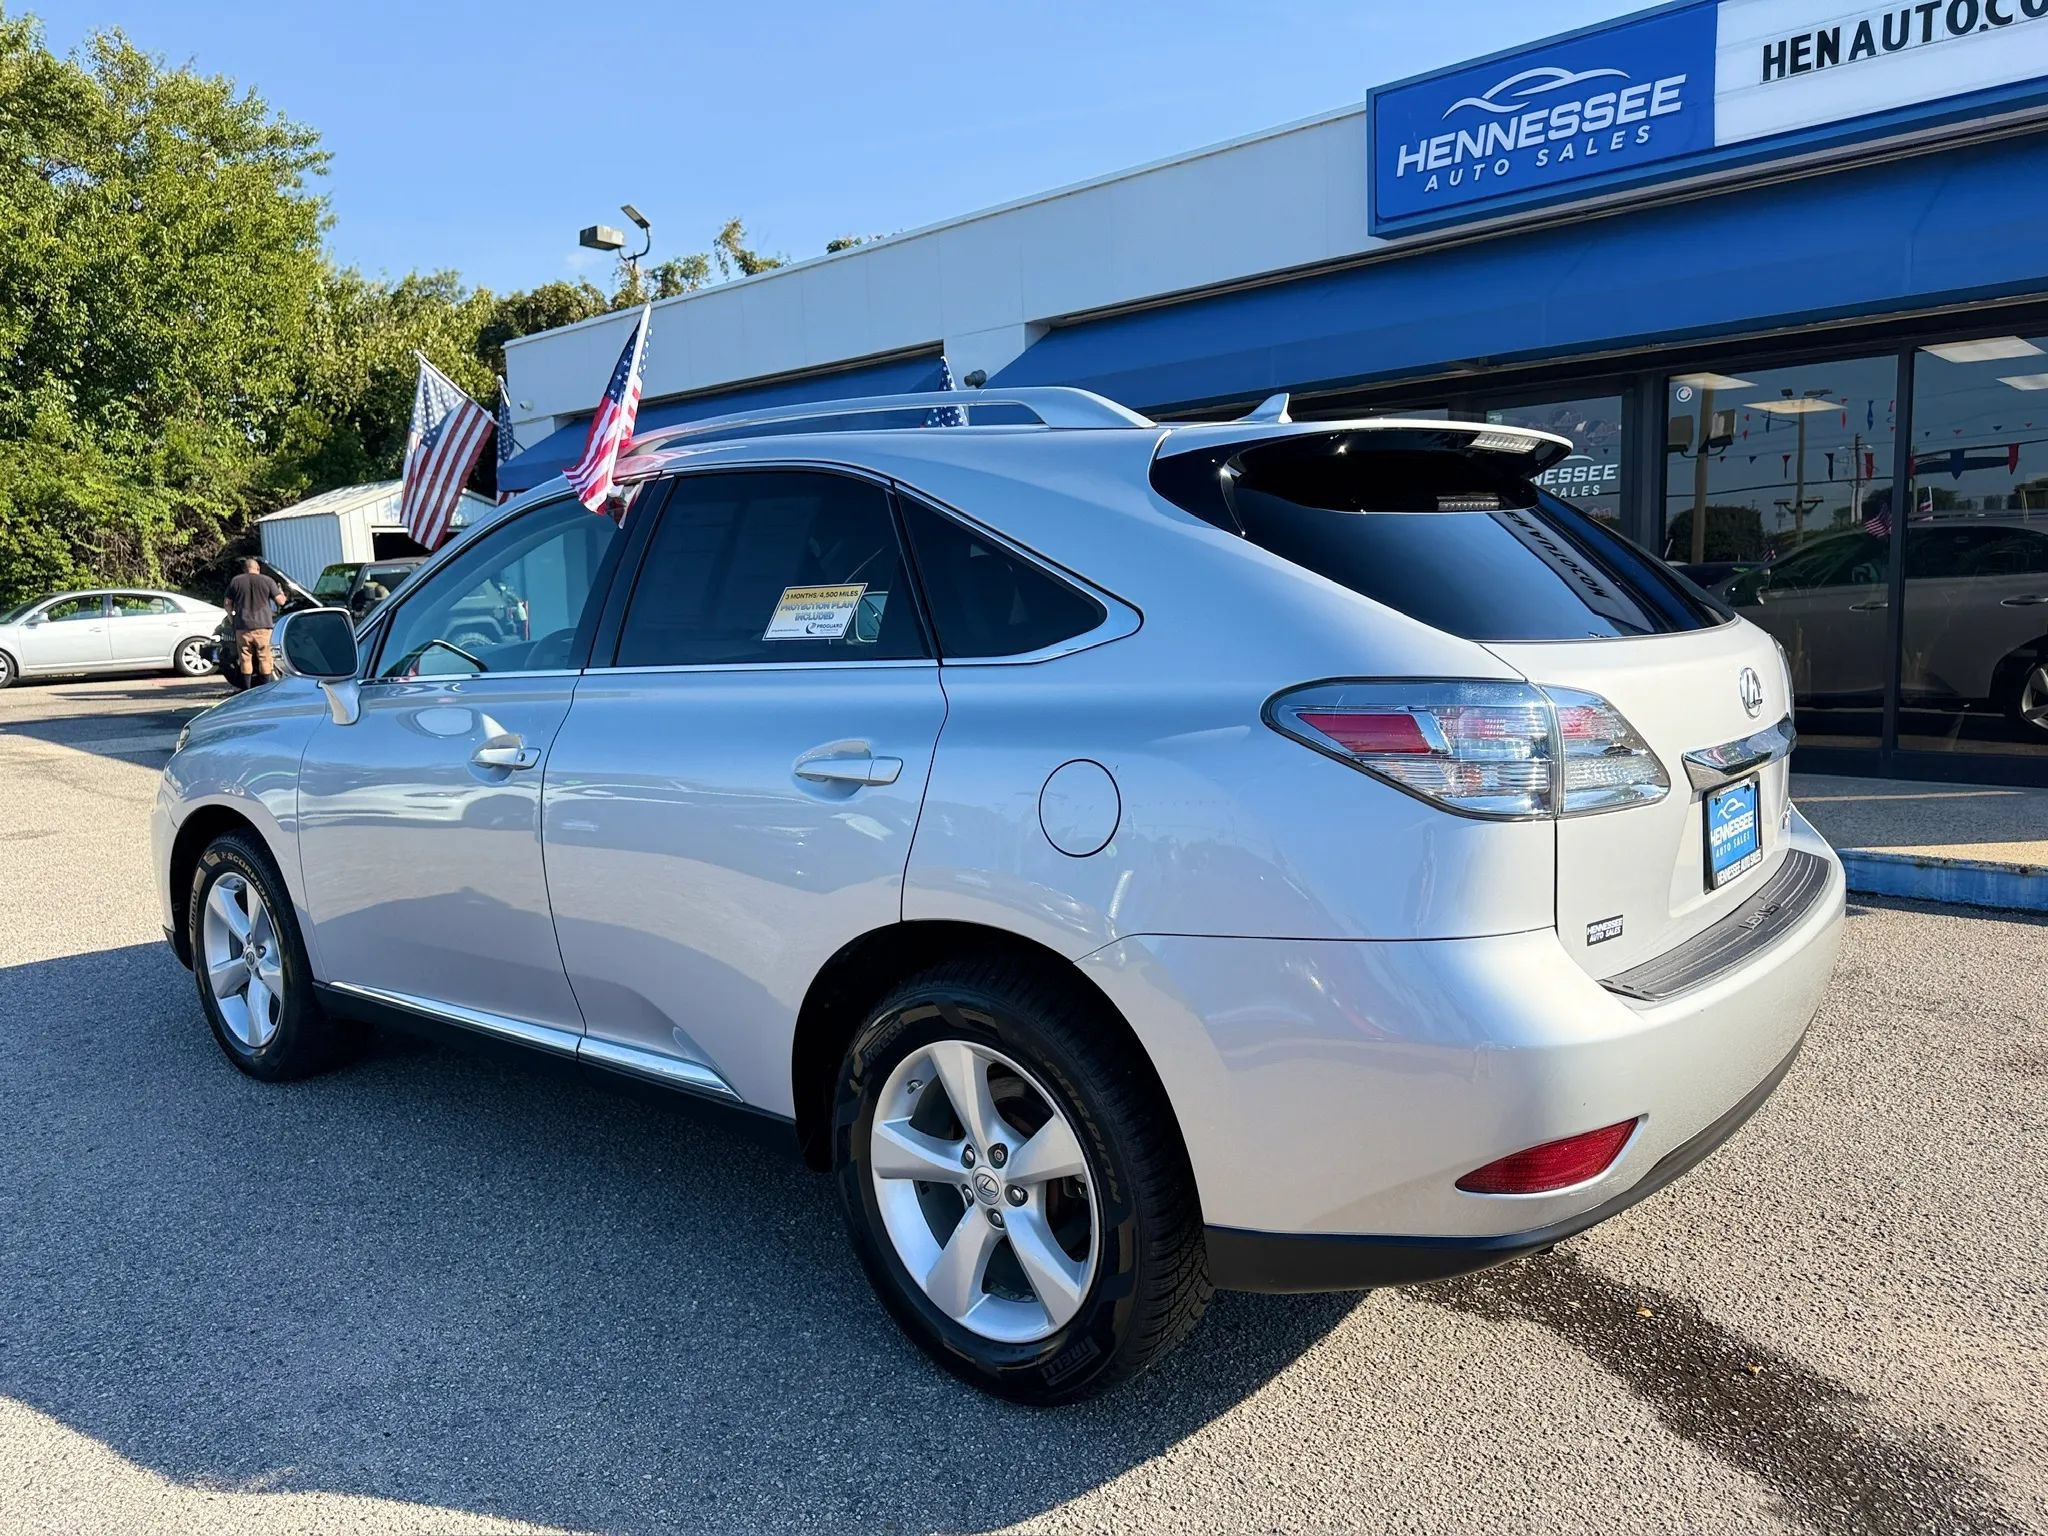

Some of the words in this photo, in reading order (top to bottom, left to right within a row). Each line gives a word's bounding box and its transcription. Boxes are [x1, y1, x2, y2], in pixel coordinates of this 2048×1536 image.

[1396, 74, 1687, 178] HENNESSEE
[1424, 157, 1510, 193] AUTO
[1535, 124, 1652, 168] SALES
[1550, 484, 1600, 498] SALES
[780, 602, 831, 611] PROTECTION
[831, 600, 854, 609] PLAN
[838, 590, 859, 598] MILES
[794, 611, 835, 621] INCLUDED
[1710, 810, 1754, 847] HENNESSEE
[1715, 843, 1731, 858] AUTO
[1733, 830, 1750, 848] SALES
[227, 852, 271, 907] SCORPION
